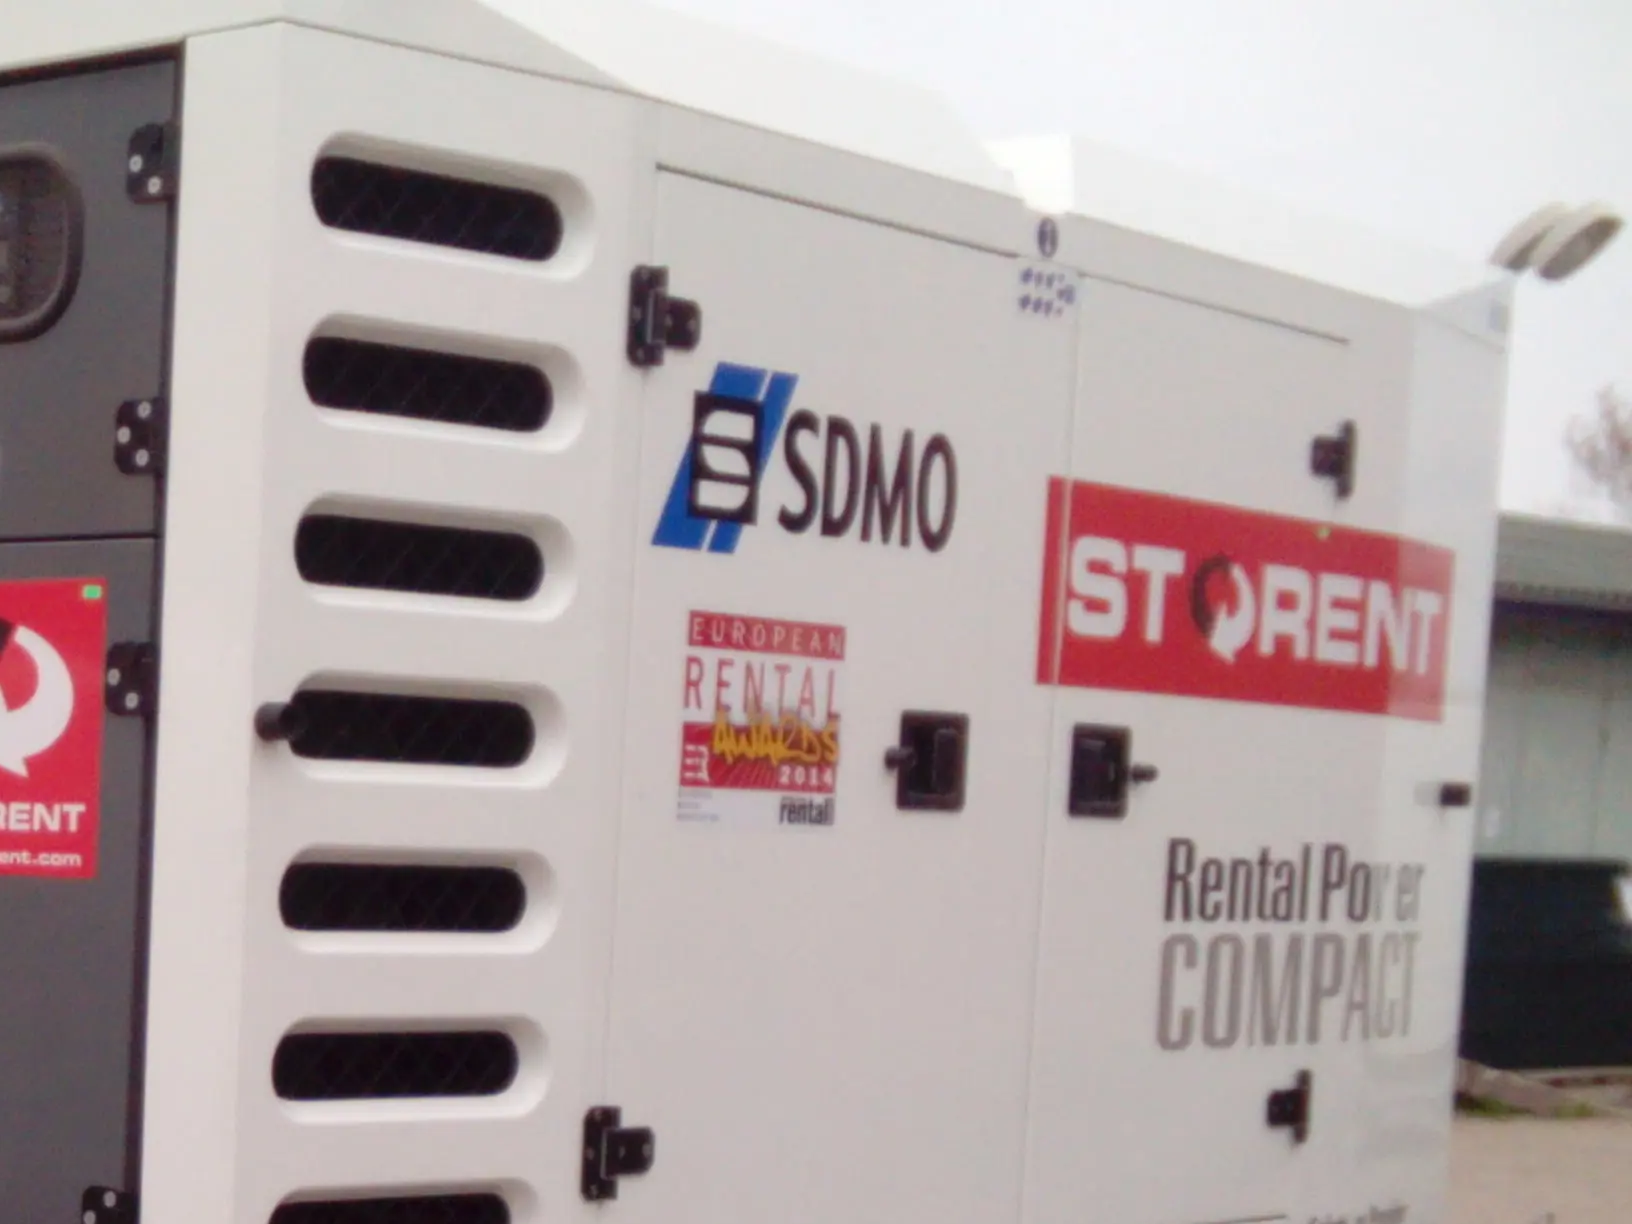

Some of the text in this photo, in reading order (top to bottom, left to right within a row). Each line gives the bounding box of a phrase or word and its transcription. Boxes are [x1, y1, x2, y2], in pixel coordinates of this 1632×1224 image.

[777, 407, 958, 554] SDMO
[691, 617, 843, 655] EUROPEAN
[1068, 535, 1440, 675] STORENT
[684, 655, 840, 718] RENTAL
[1164, 837, 1312, 923] Rental
[1156, 931, 1422, 1051] COMPACT
